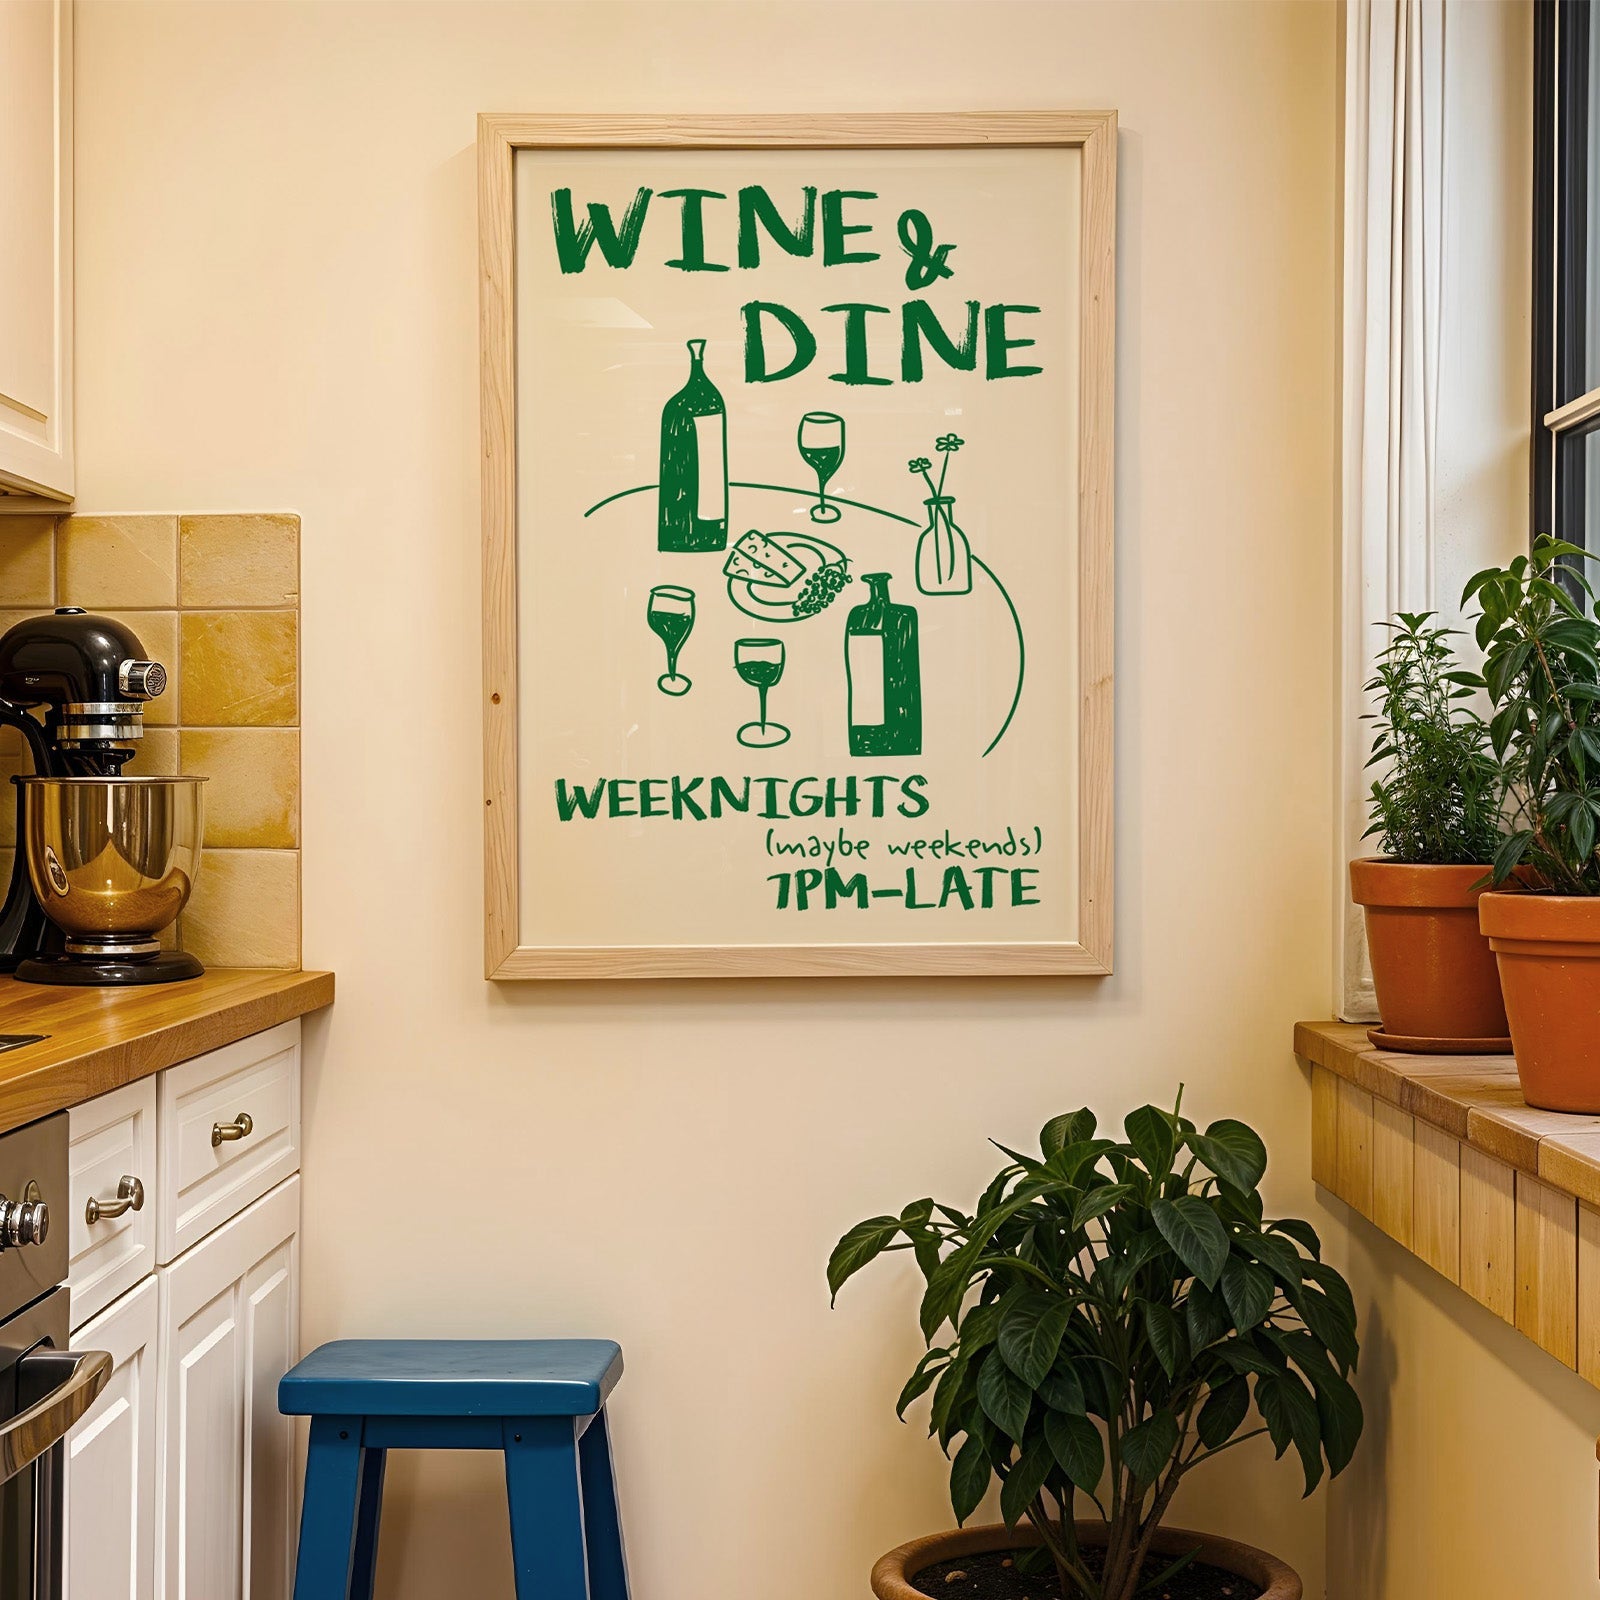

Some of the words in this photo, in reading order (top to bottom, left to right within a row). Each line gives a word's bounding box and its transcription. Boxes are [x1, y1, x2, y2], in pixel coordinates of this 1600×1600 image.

[551, 185, 881, 274] WINE
[897, 208, 957, 291] &
[740, 299, 1043, 386] DINE
[555, 775, 930, 821] WEEKNIGHTS
[766, 827, 870, 866] (maybe
[887, 826, 1042, 859] weekends)
